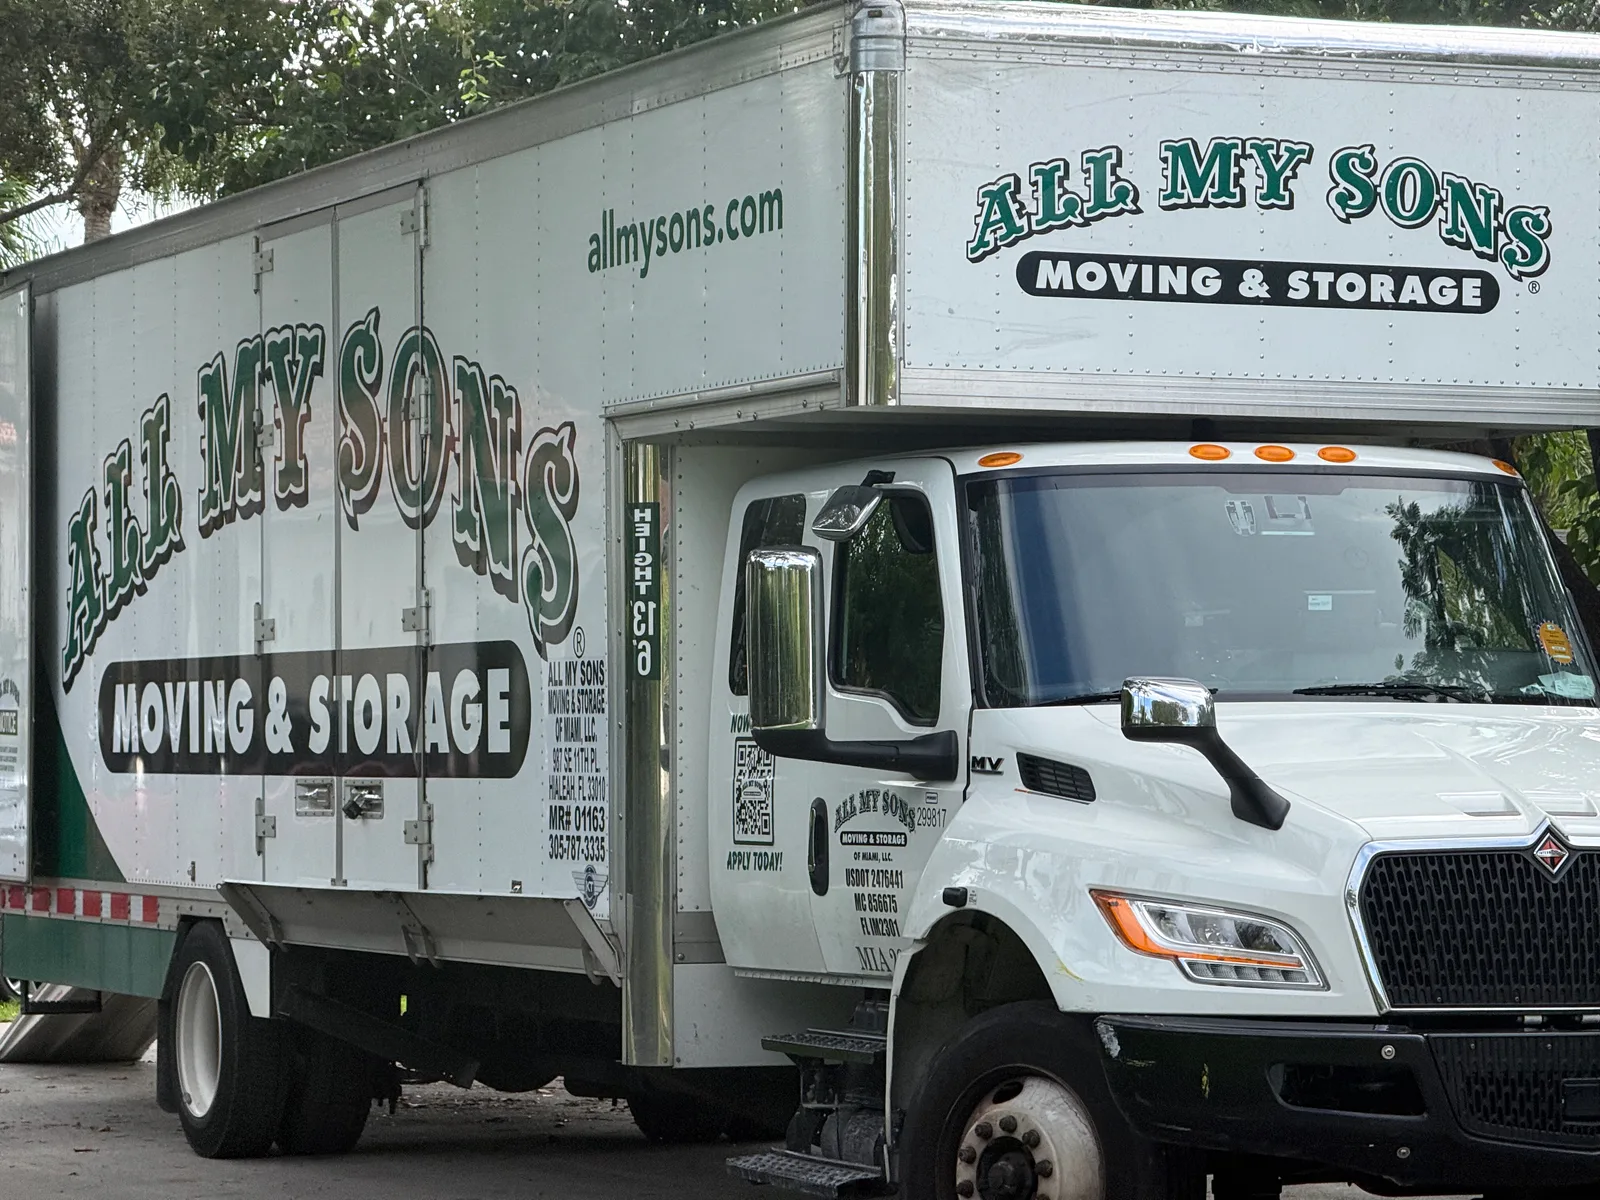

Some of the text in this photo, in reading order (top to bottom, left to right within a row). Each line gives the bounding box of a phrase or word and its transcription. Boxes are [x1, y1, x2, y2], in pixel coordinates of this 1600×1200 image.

[966, 136, 1552, 282] ALL MY SONS
[588, 188, 783, 279] allmysons.com
[1035, 259, 1482, 307] MOVING & STORAGE
[62, 305, 580, 695] ALL MY SONS
[548, 659, 605, 687] ALL MY SONS
[112, 668, 511, 755] MOVING & STORAGE
[548, 688, 606, 715] MOVING & STORAGE
[555, 716, 598, 745] OF MIAMI, LLC.
[563, 747, 573, 773] SE
[573, 747, 589, 773] 11TH
[971, 755, 1005, 771] MV
[577, 775, 587, 801] FL
[587, 775, 606, 802] 33010
[549, 804, 606, 832] MR# 01163
[834, 789, 915, 833] ALL MY SONS
[917, 808, 946, 828] 299817
[548, 833, 606, 862] 305-787-3335
[842, 833, 905, 845] MOVING & STORAGE
[726, 850, 783, 872] APPLY TODAY!
[853, 851, 861, 861] OF
[862, 852, 880, 863] MIAMI,
[845, 867, 904, 889] USDOT 2476441
[853, 892, 898, 914] MC 856675
[859, 916, 871, 936] FL
[855, 945, 892, 973] MIA
